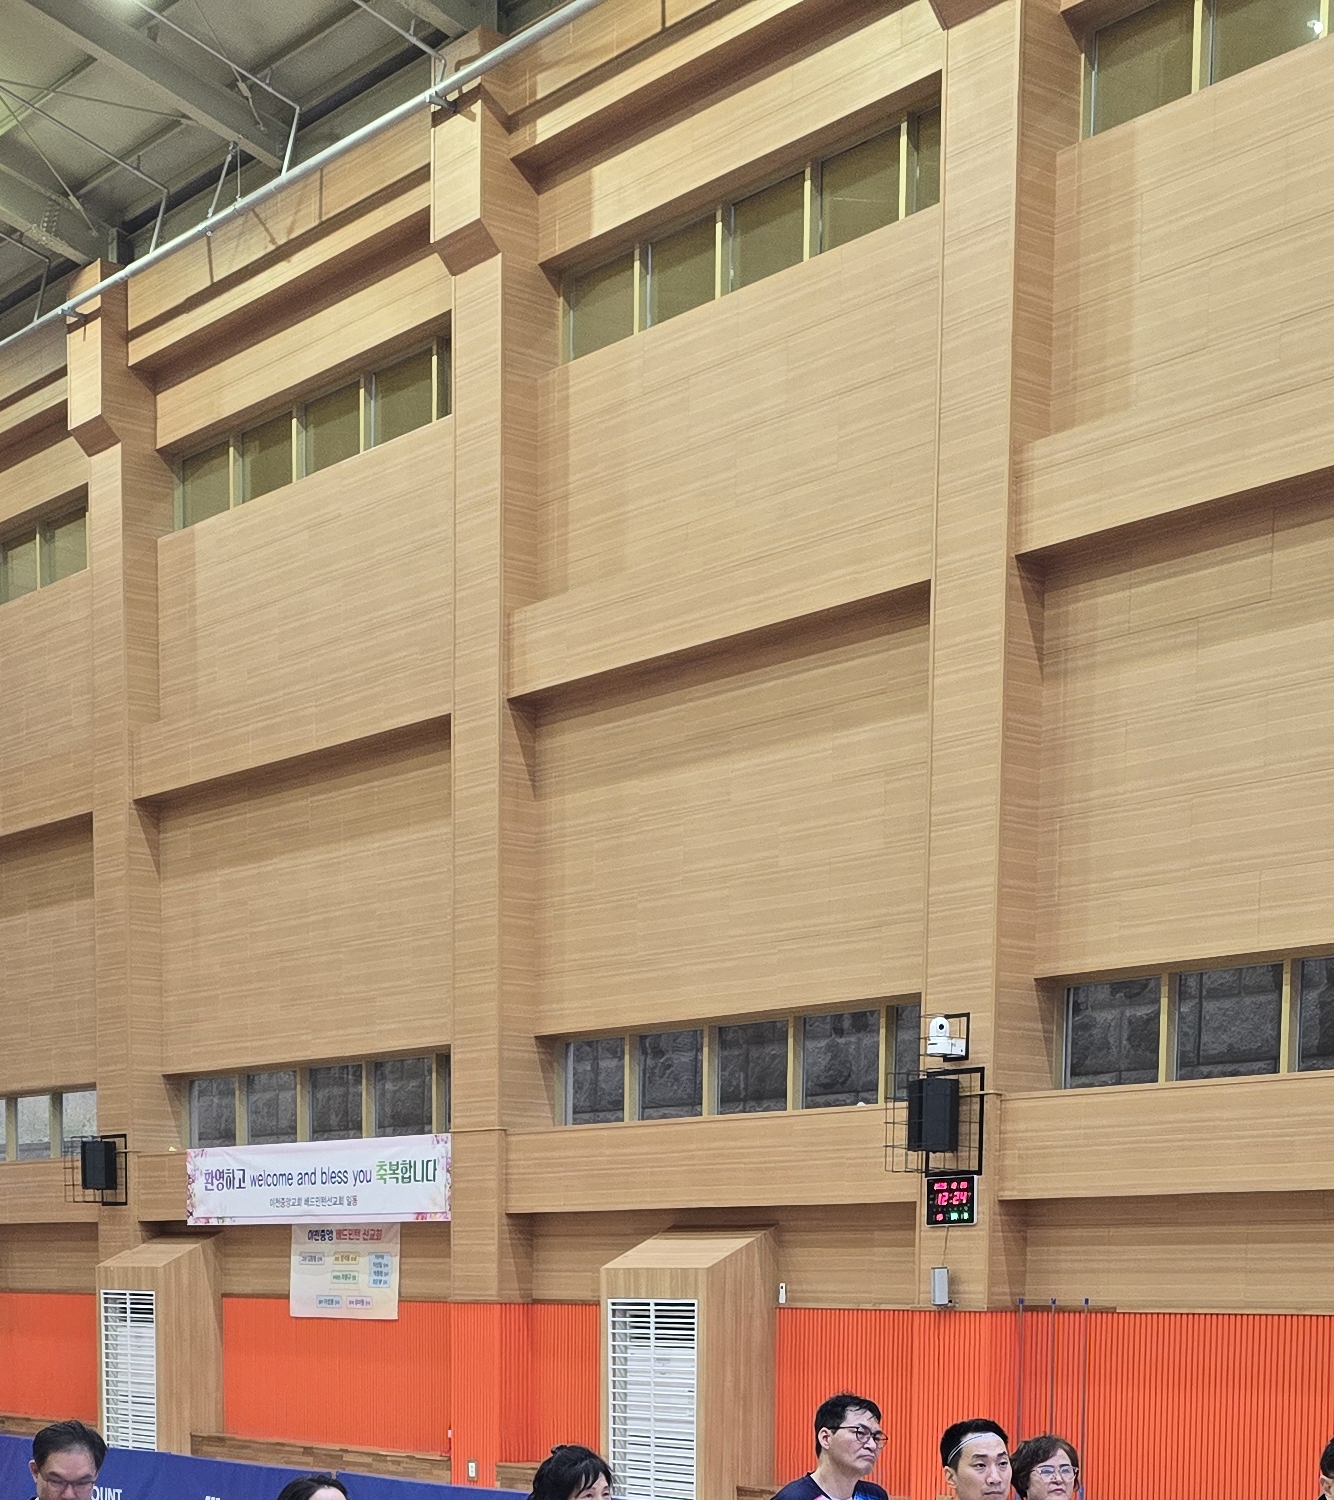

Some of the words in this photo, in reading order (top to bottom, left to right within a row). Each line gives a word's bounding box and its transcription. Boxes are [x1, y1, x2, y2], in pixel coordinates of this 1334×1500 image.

[203, 1168, 247, 1192] 환영하고
[249, 1170, 294, 1188] welcome
[296, 1166, 317, 1186] and
[320, 1165, 349, 1185] bless
[352, 1168, 372, 1188] you
[375, 1159, 438, 1185] 축복합니다
